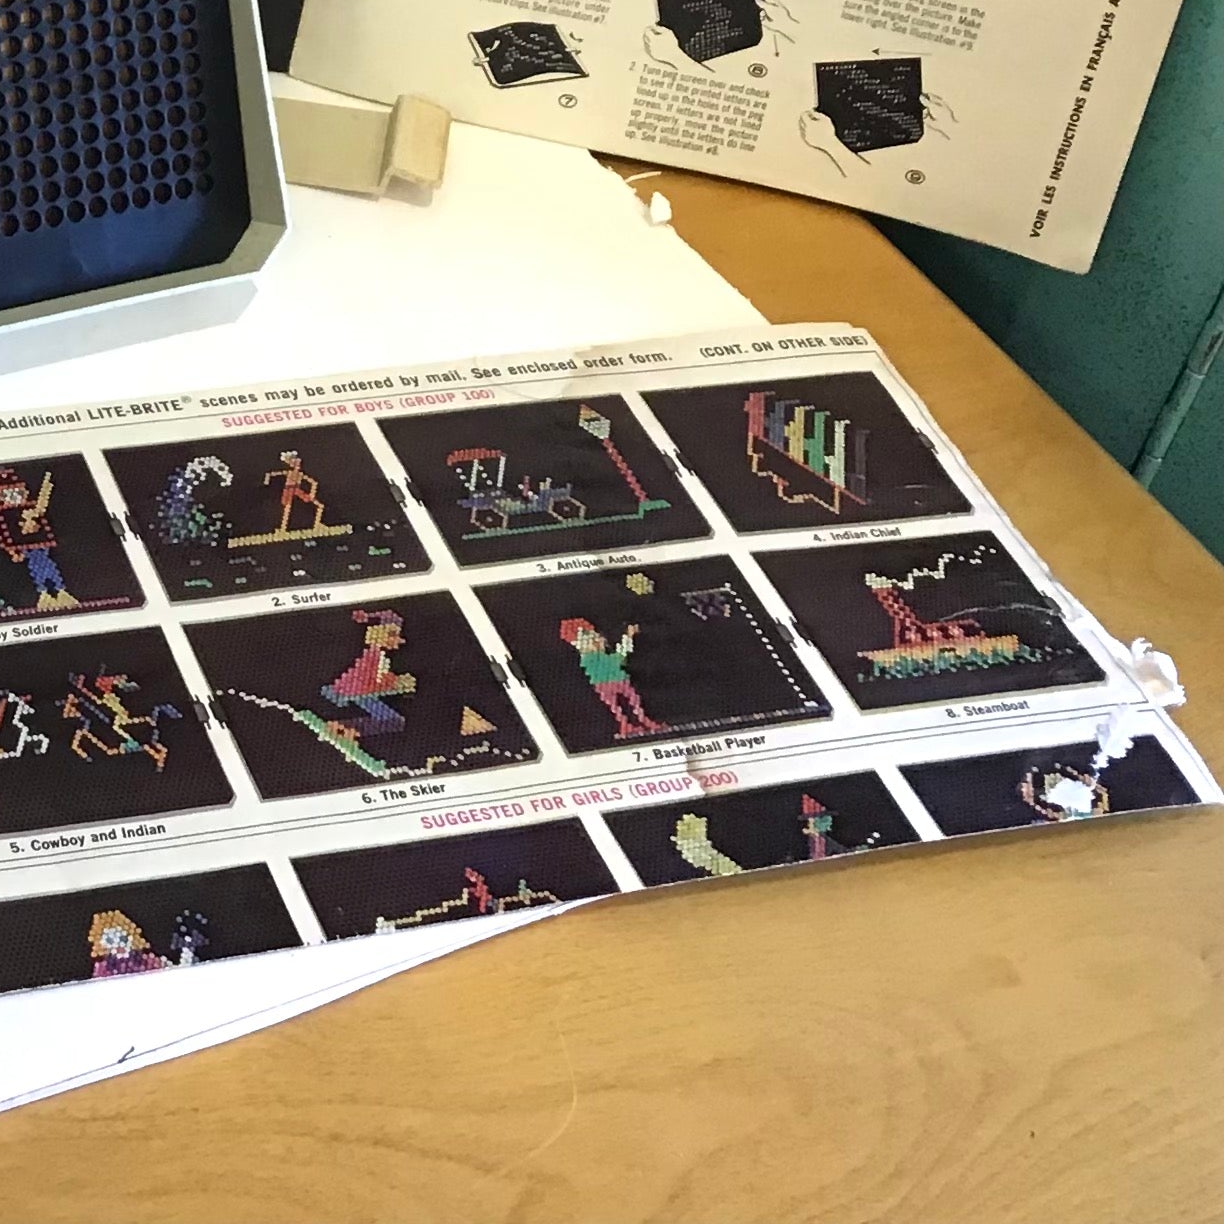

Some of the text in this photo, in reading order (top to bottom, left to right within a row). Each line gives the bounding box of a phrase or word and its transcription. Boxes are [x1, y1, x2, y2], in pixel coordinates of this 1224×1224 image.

[1030, 210, 1048, 237] VOIR
[1042, 186, 1056, 204] LES
[1050, 97, 1086, 180] INSTRUCTIONS
[1080, 76, 1093, 92] EN
[1087, 13, 1115, 70] FRANÇAIS
[700, 333, 869, 358] (CONT. ON OTHER SIDE)
[200, 394, 258, 407] scenes
[265, 389, 298, 400] may
[304, 386, 325, 396] be
[332, 377, 393, 393] ordered
[399, 376, 419, 387] by
[426, 370, 466, 383] mail.
[471, 368, 501, 379] See
[508, 359, 577, 375] enclosed
[584, 356, 623, 368] order
[629, 353, 672, 364] form.
[222, 387, 495, 427] SUGGESTED FOR BOYS (GROUP 100)
[830, 531, 867, 540] Indian
[870, 527, 901, 537] Chief
[536, 564, 550, 572] 3.
[558, 559, 605, 570] Antique
[272, 592, 330, 607] 2. Surfer
[12, 625, 58, 637] Soldier
[945, 701, 1029, 718] 8. Steamboat
[632, 736, 765, 762] 7. Basketball Player
[362, 784, 445, 803] 6. The Skier
[421, 772, 738, 829] SUGGESTED FOR GIRLS (GROUP 200)
[10, 825, 166, 853] 5. Cowboy and Indian
